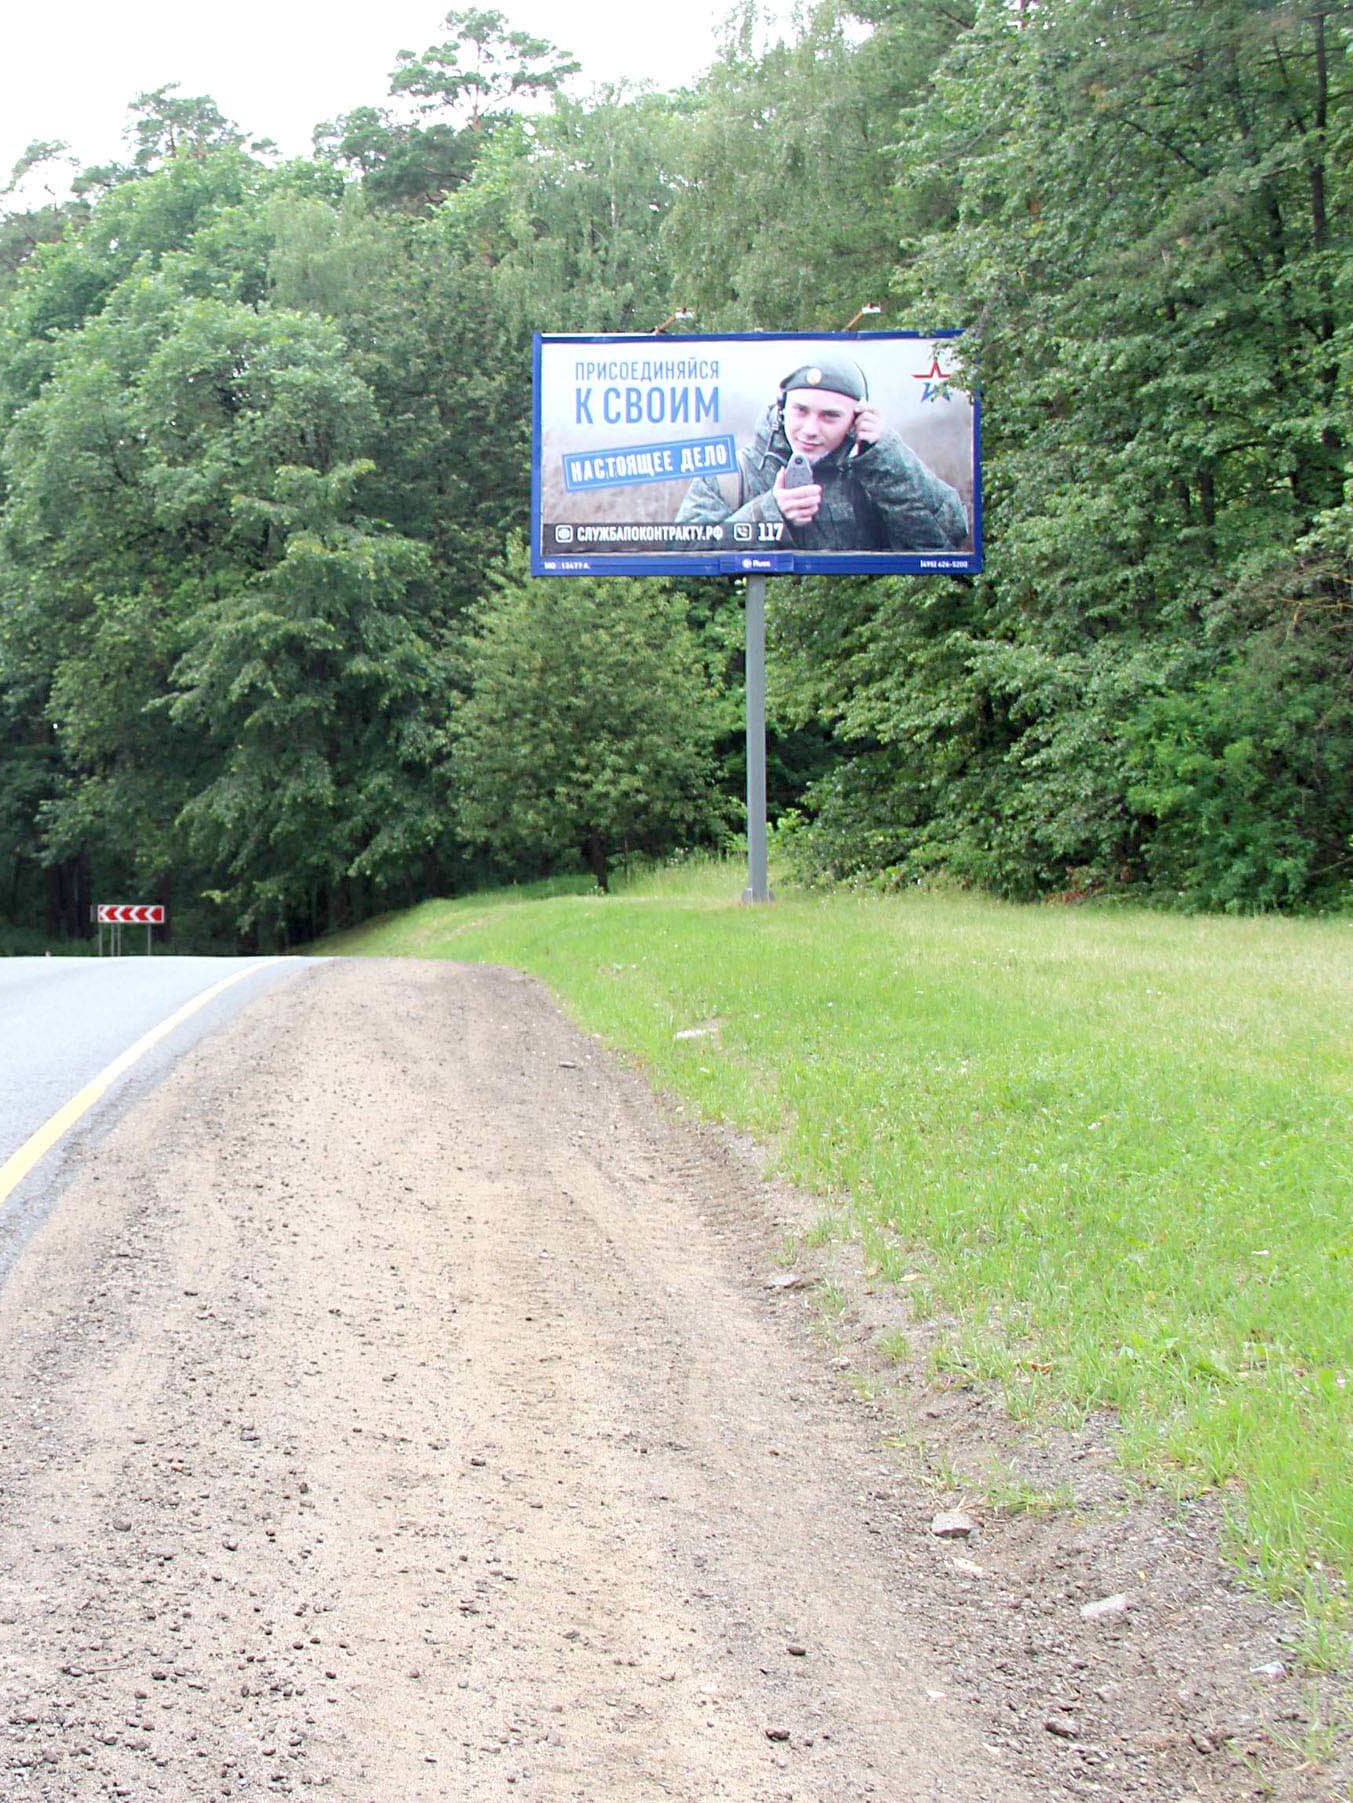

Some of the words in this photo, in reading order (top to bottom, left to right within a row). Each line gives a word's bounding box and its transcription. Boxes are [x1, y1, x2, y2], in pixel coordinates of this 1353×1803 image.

[575, 357, 720, 382] ПРИСОЕДИНЯЙСЯ
[575, 387, 594, 425] К
[603, 386, 719, 425] СВОИМ
[570, 450, 674, 483] НАСТОЯЩЕЕ
[680, 443, 728, 473] ДЕЛО
[577, 525, 723, 542] СЛУЖБАПОКОНТРАКТУ.РФ
[758, 523, 784, 541] 117
